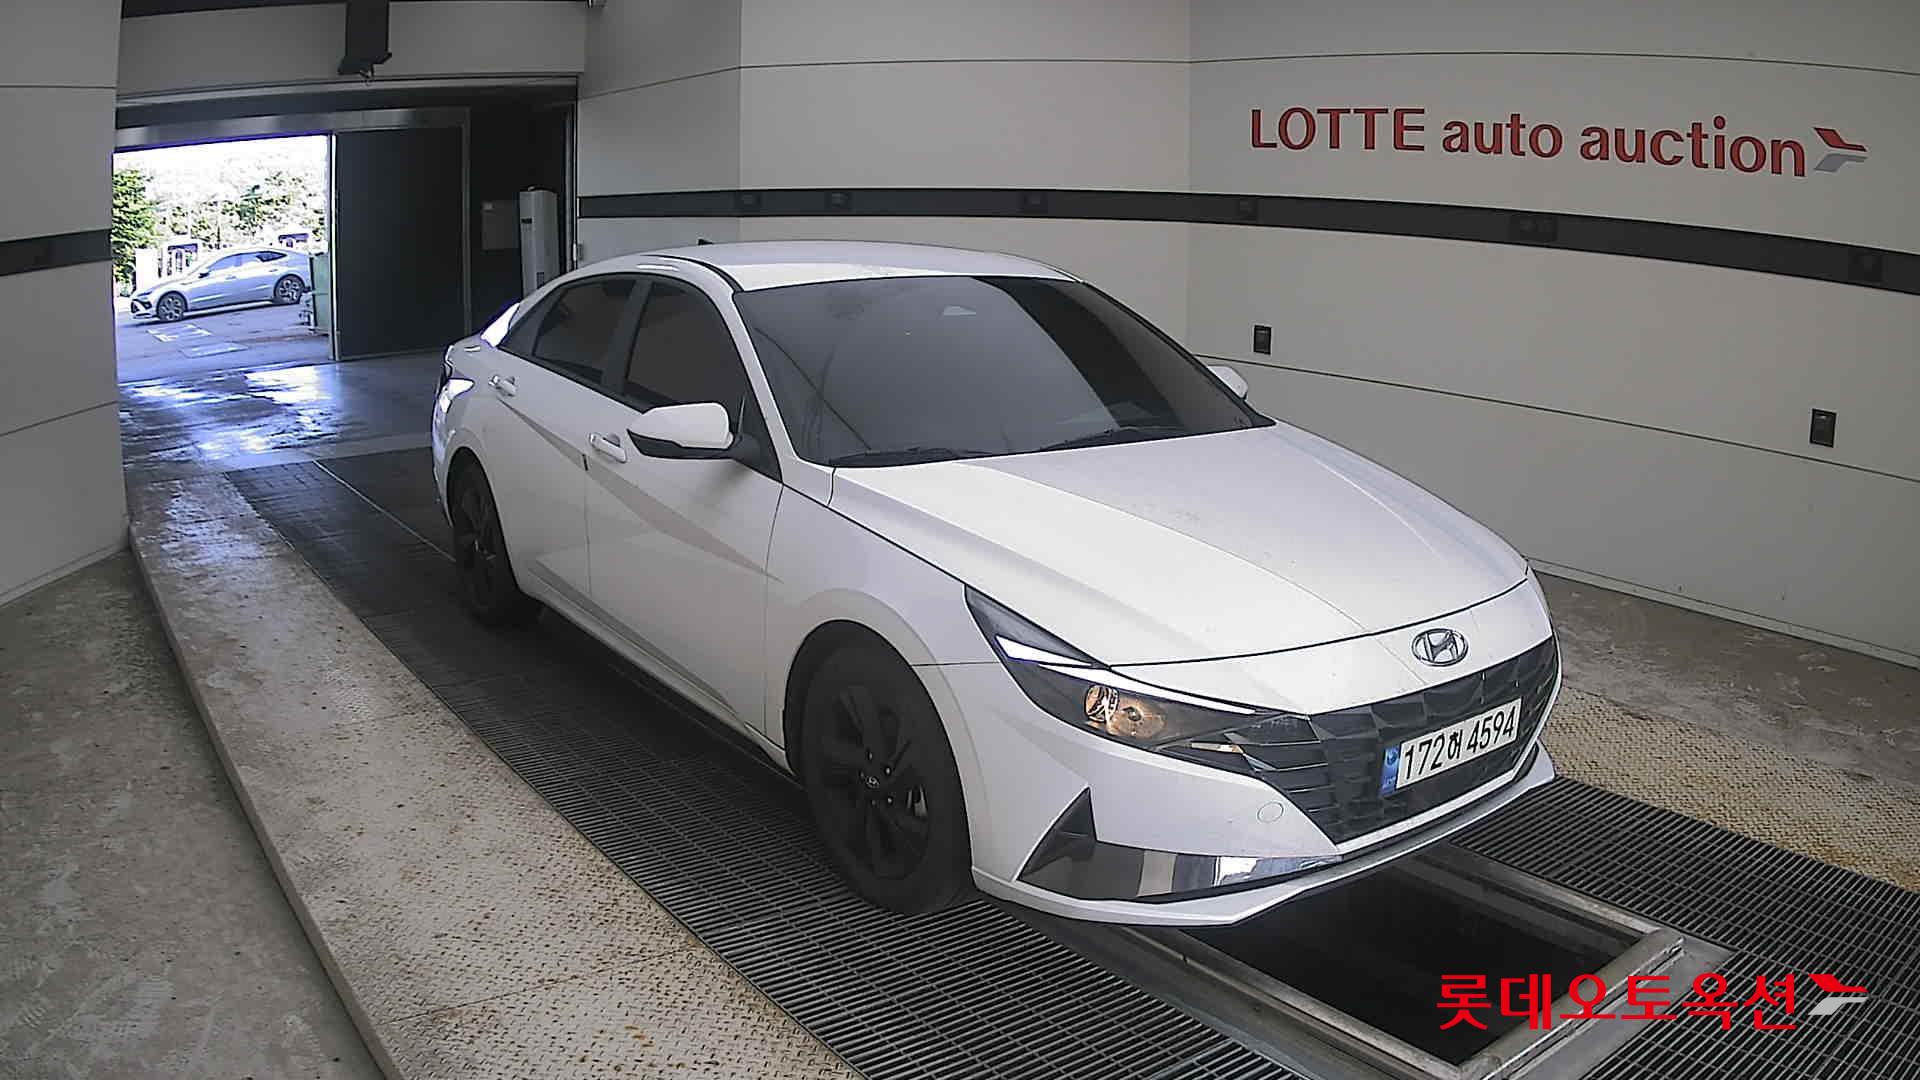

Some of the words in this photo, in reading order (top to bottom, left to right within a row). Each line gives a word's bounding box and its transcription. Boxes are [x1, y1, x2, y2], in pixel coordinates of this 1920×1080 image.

[1250, 107, 1426, 152] LOTTE
[1441, 113, 1563, 159] auto
[1579, 116, 1807, 177] auction
[1404, 729, 1463, 780] 172허
[1466, 706, 1516, 753] 4594
